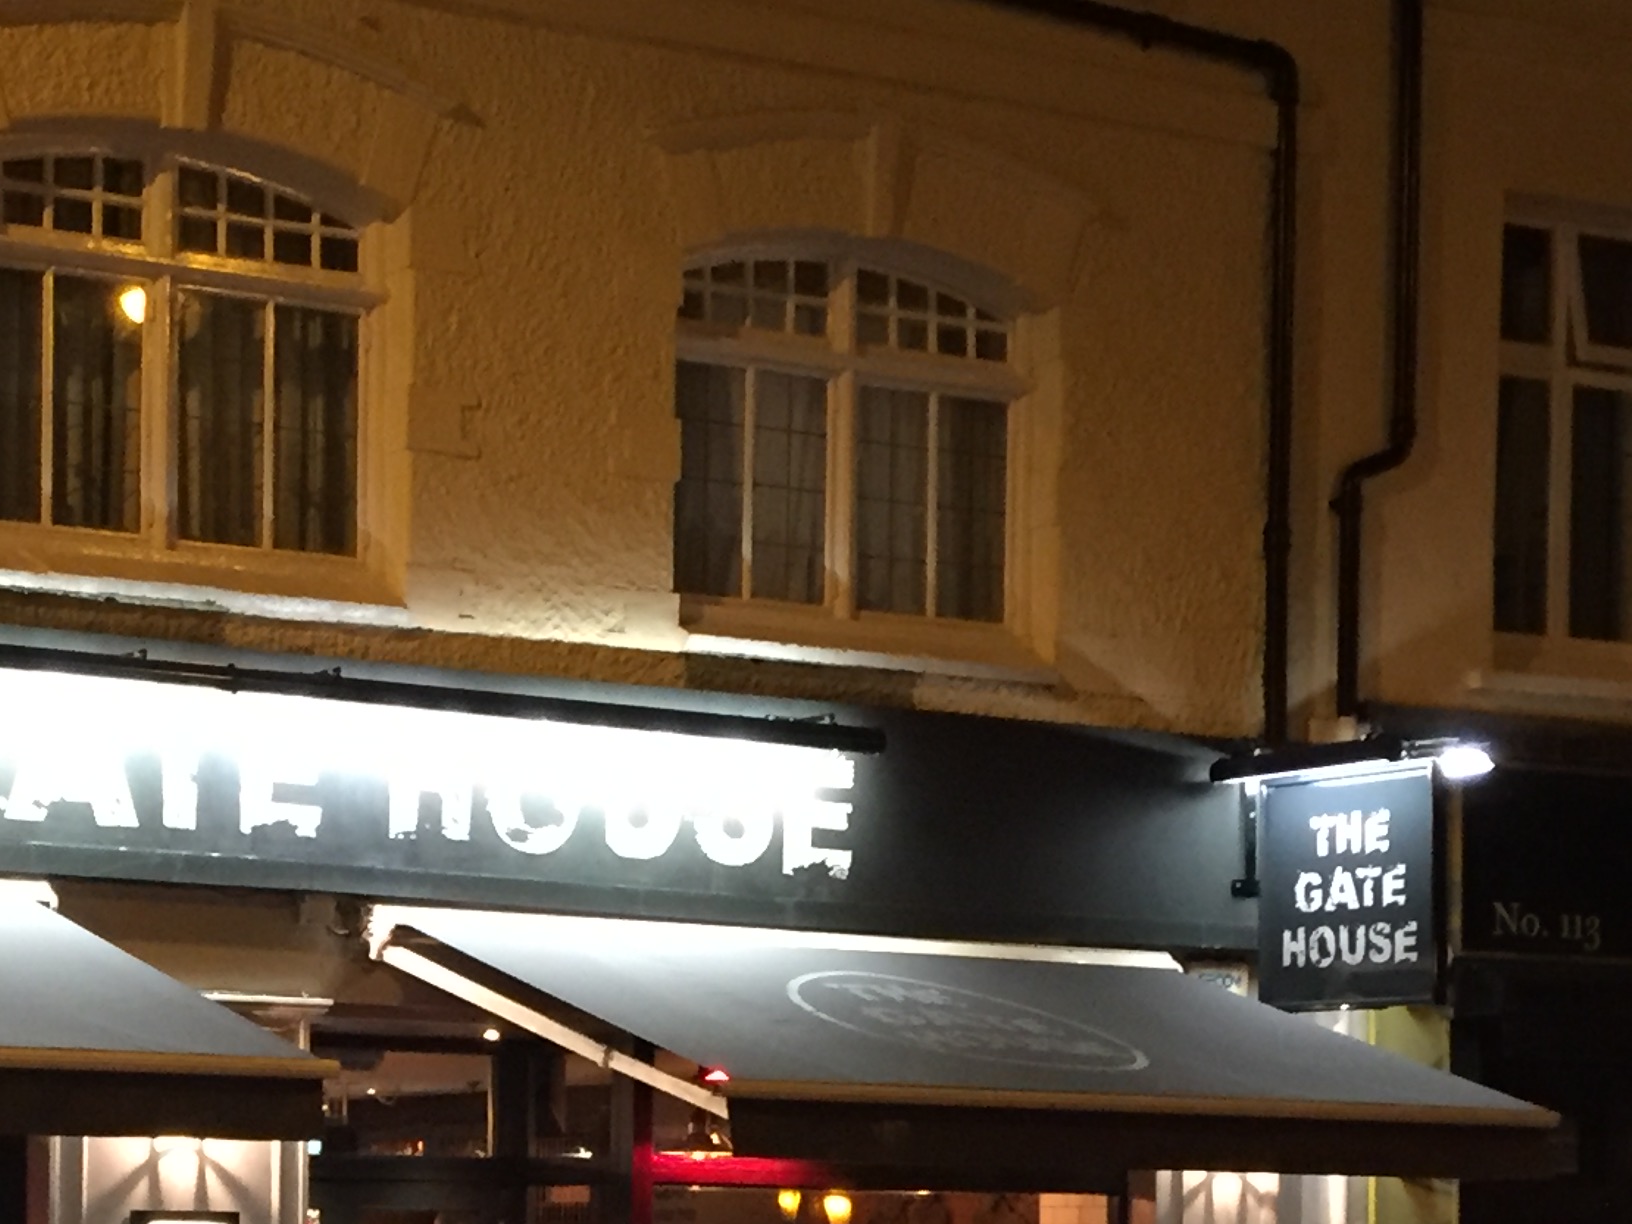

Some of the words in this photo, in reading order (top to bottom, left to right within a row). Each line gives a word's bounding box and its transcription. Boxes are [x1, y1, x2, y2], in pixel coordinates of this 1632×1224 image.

[1309, 807, 1392, 857] THE
[1294, 863, 1407, 913] GATE
[1282, 920, 1419, 968] HOUSE
[1491, 901, 1550, 938] No.
[1559, 912, 1603, 952] 113
